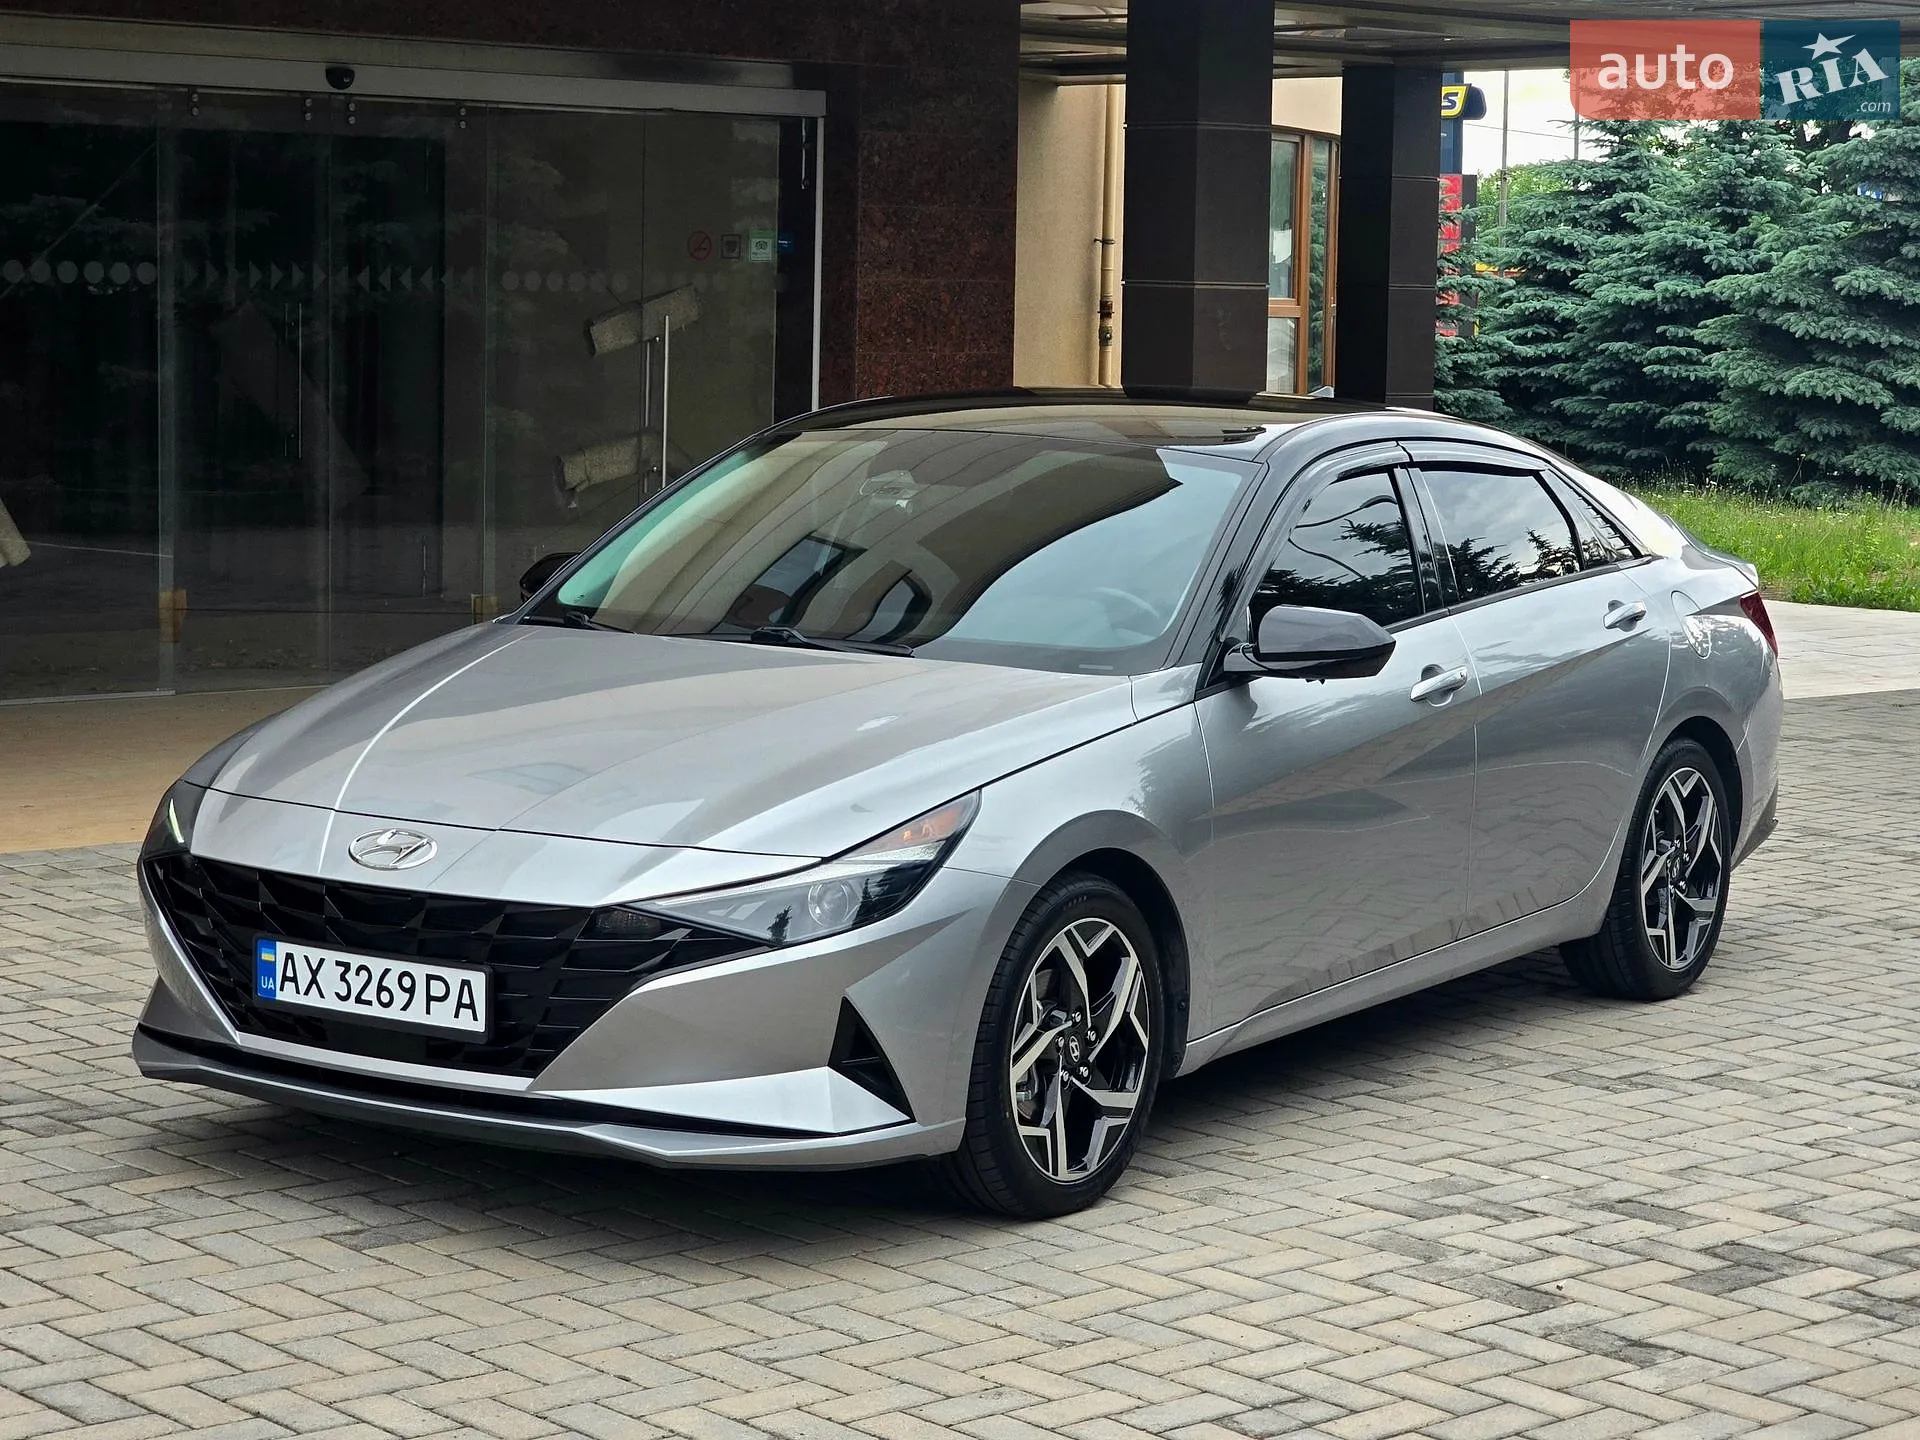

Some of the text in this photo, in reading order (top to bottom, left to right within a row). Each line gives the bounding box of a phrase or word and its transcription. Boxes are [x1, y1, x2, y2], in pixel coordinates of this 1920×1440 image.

[261, 975, 275, 990] UA
[279, 952, 479, 1022] AX 3269 PA
